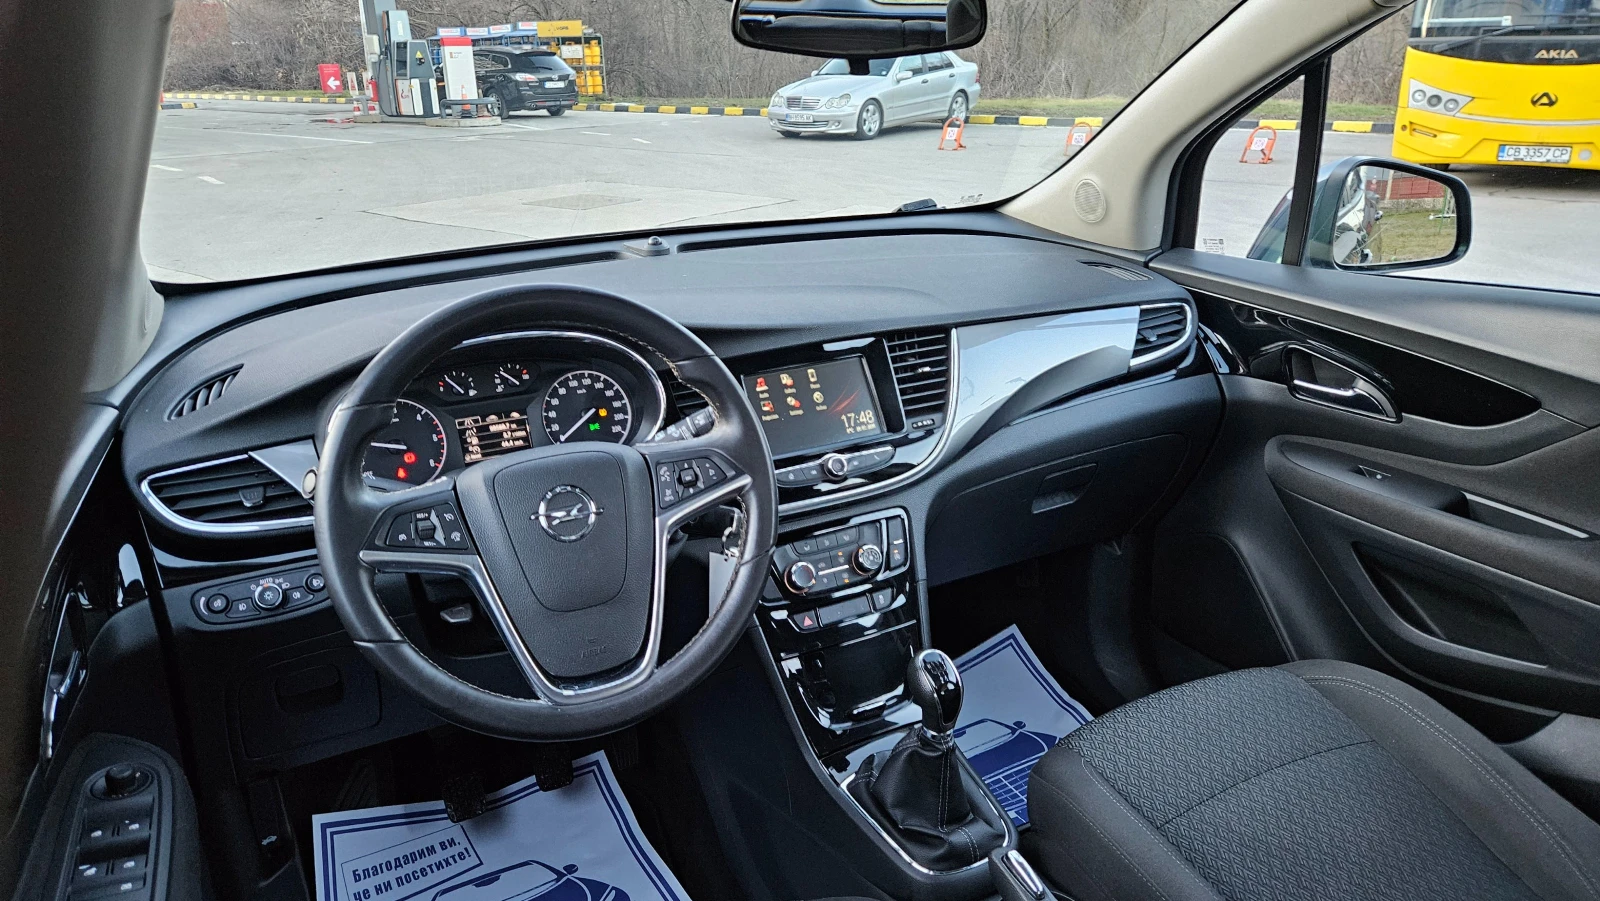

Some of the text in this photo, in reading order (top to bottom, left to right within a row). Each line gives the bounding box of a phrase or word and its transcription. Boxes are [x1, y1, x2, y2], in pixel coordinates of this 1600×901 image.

[1534, 49, 1579, 58] AKIA
[1506, 147, 1569, 158] CB 3357 CP
[841, 409, 875, 428] 17:48
[259, 577, 273, 585] AUTO
[352, 837, 461, 883] Благодарим ви,
[374, 880, 393, 896] ни
[395, 847, 472, 888] посетихте!
